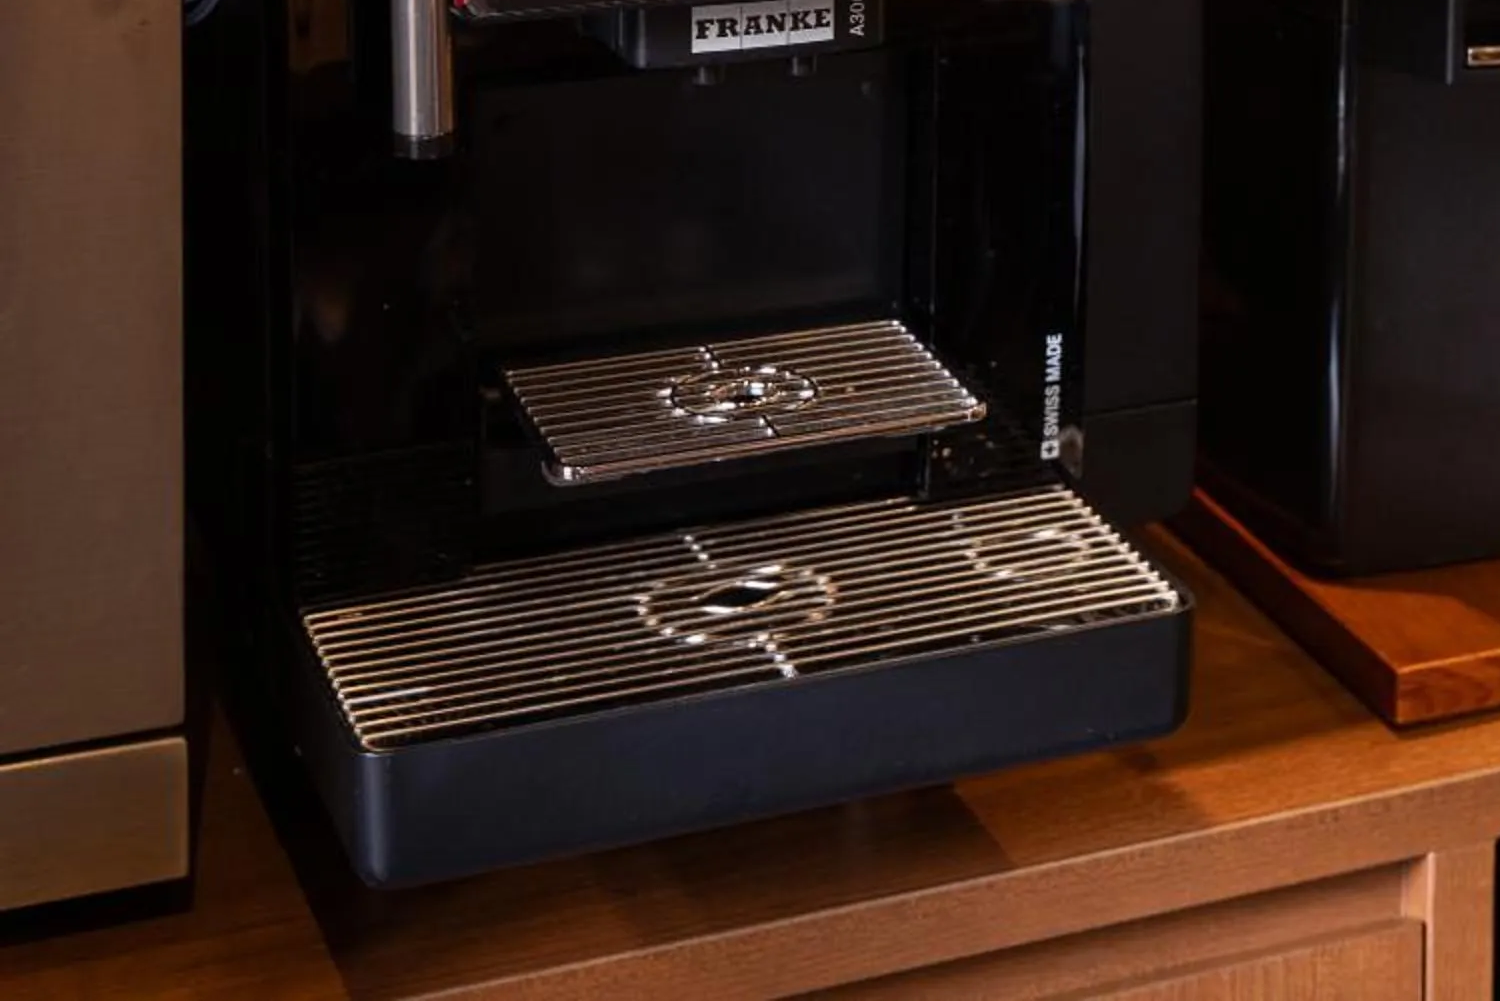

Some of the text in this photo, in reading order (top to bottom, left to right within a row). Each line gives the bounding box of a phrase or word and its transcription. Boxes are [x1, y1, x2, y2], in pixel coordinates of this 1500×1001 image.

[694, 8, 832, 40] FRANKE
[1043, 332, 1063, 437] SWISS MADE
